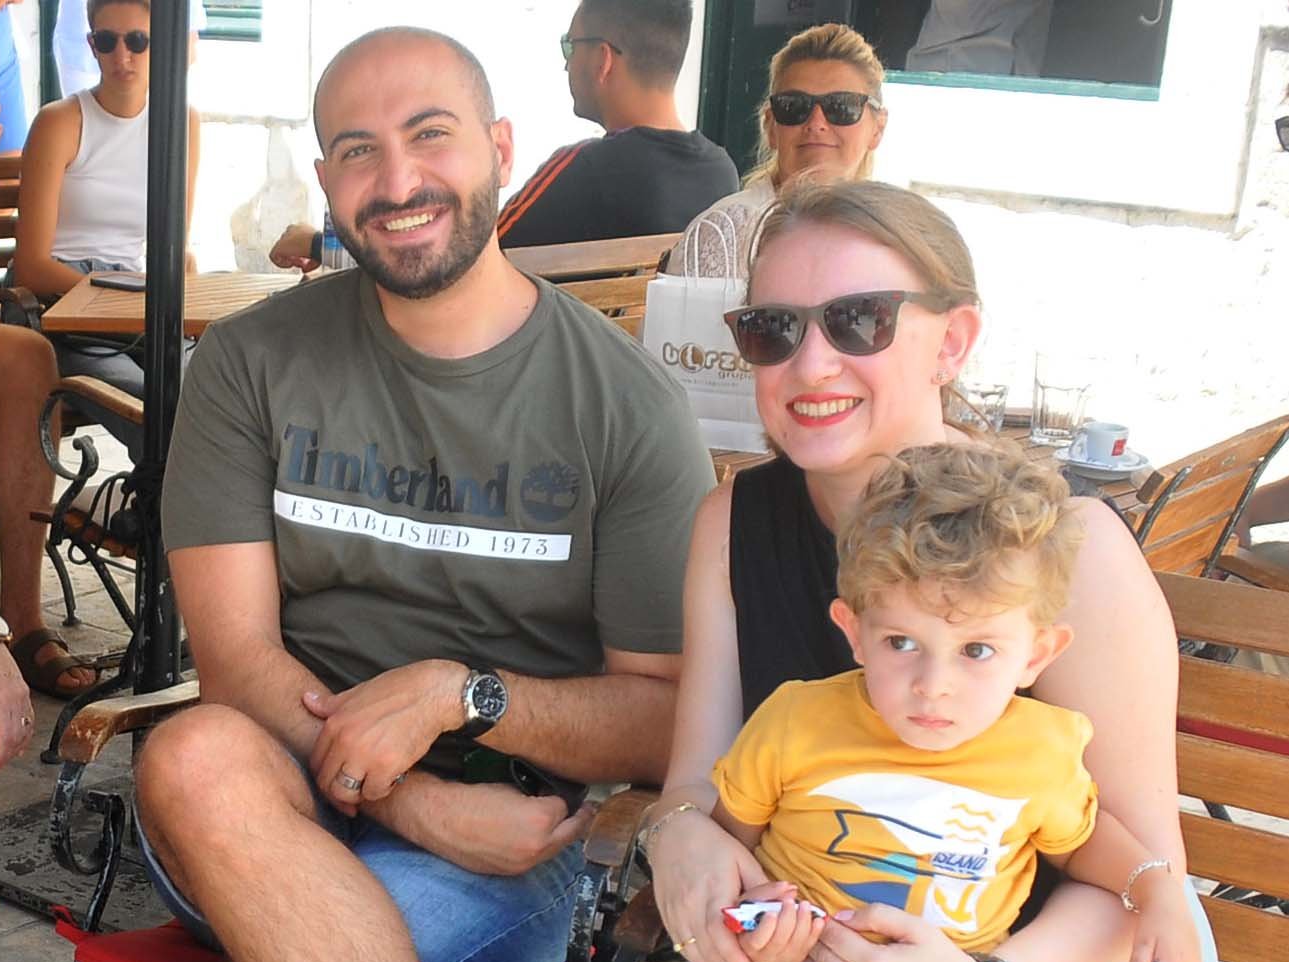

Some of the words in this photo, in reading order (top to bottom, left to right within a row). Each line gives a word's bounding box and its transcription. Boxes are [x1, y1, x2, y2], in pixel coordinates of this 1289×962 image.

[284, 423, 510, 518] Timberland
[290, 500, 470, 549] ESTABLISHED
[490, 534, 549, 556] 1973
